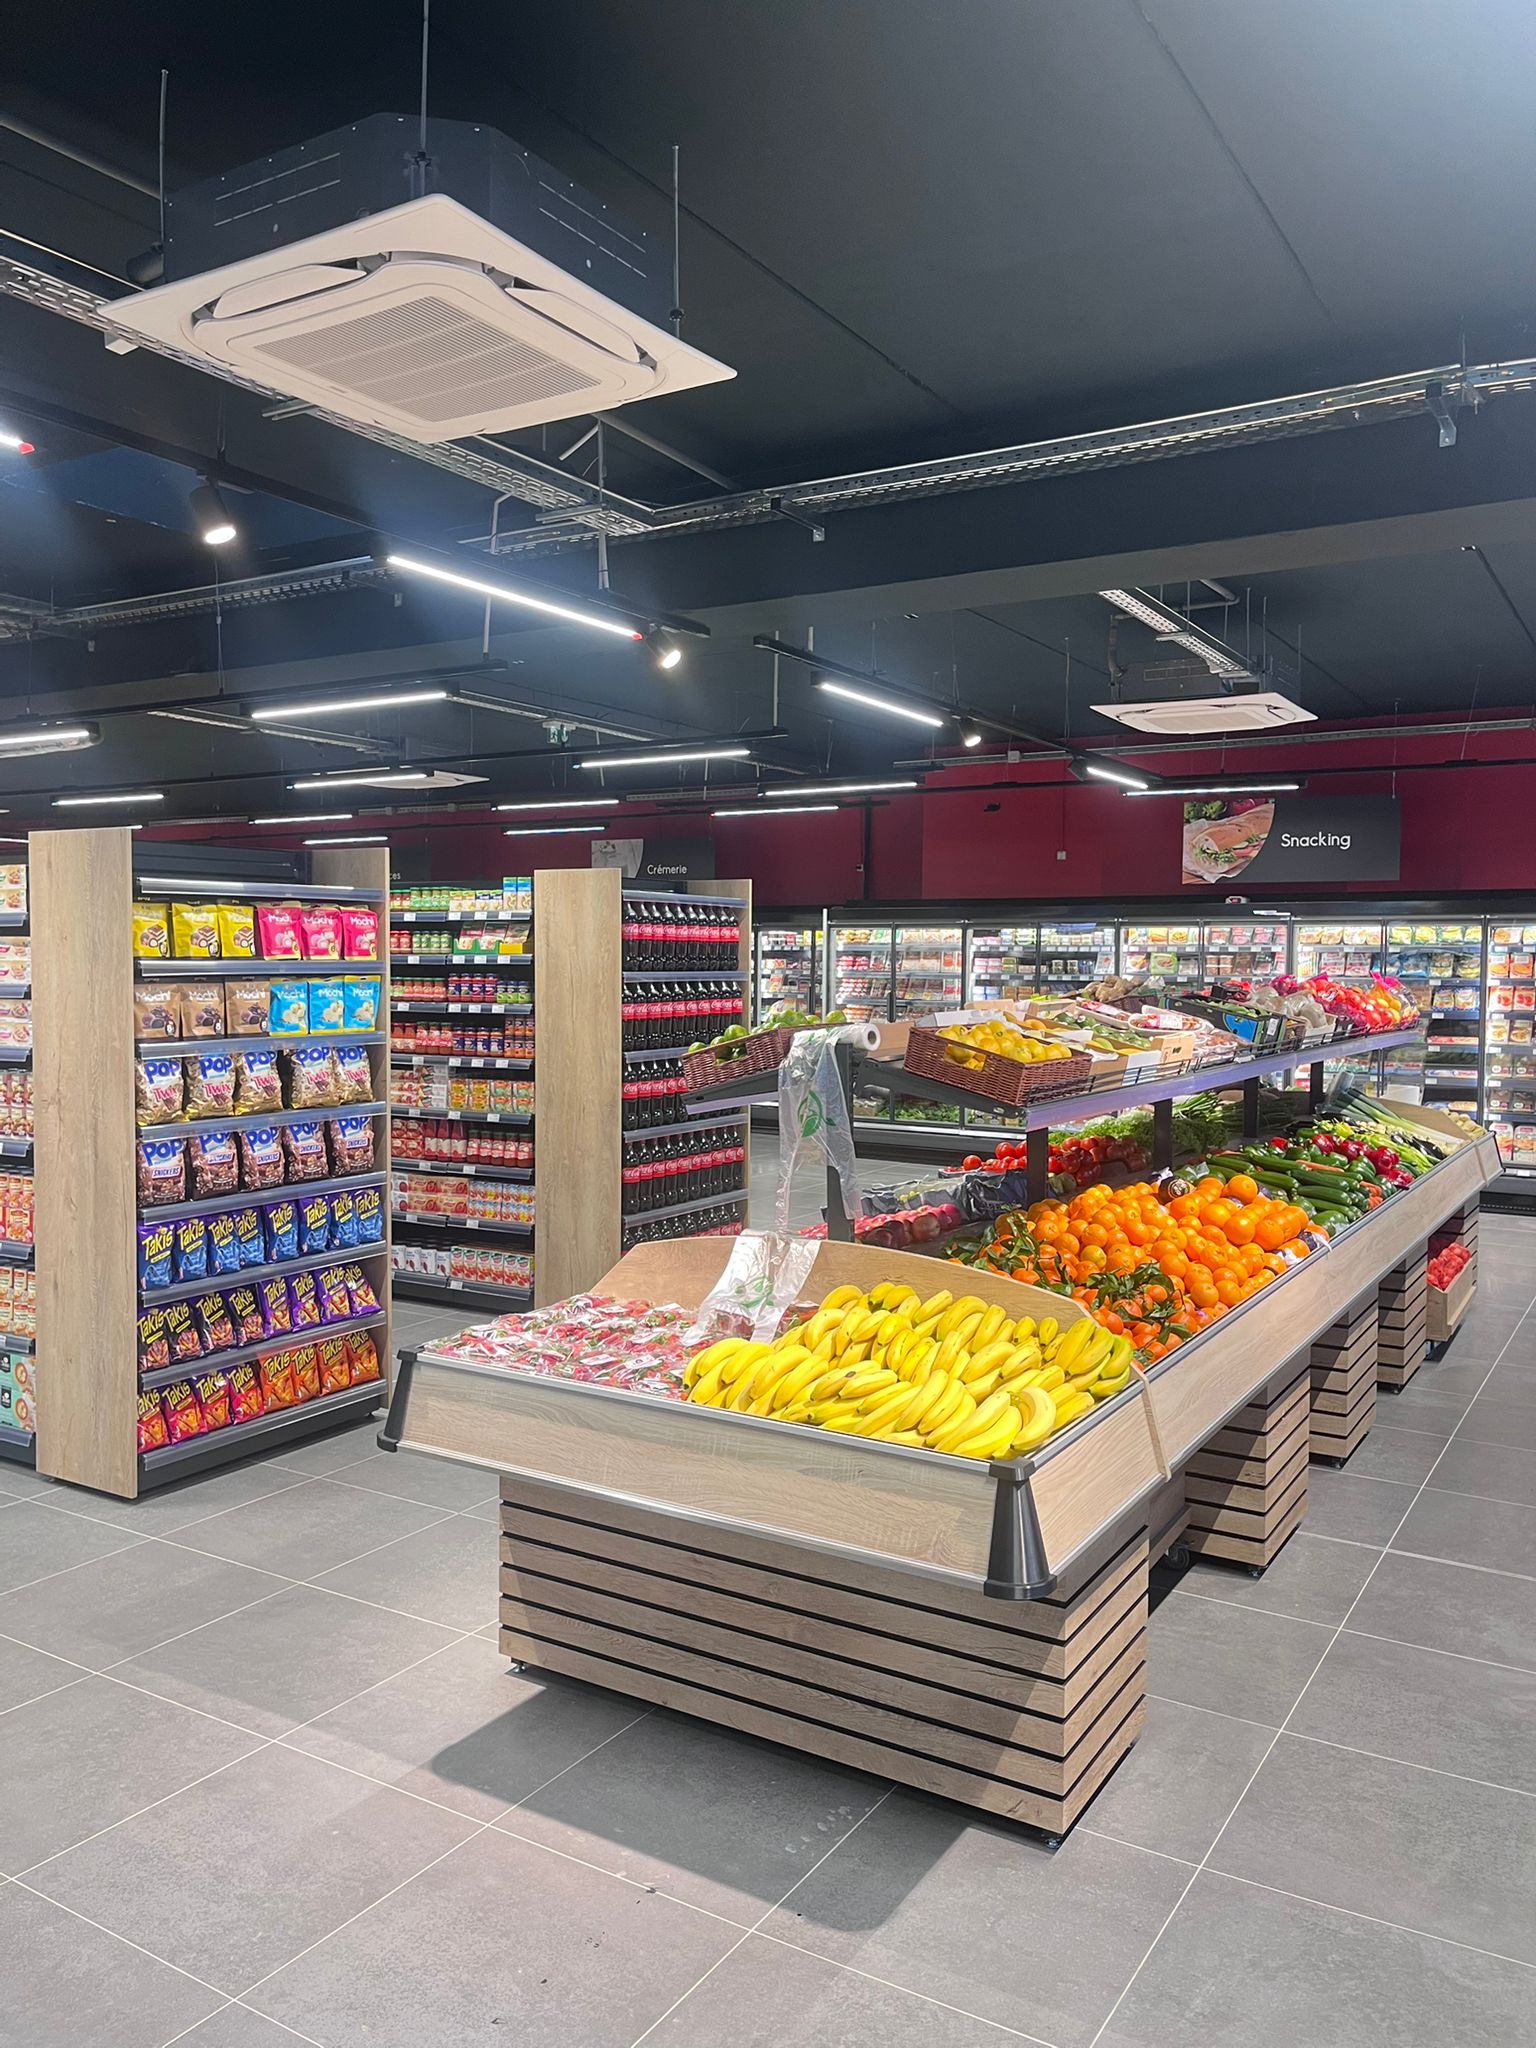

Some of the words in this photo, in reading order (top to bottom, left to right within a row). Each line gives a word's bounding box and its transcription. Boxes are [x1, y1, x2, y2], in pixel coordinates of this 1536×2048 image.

[1281, 831, 1351, 850] Snacking
[647, 863, 687, 875] Crémerie
[350, 916, 374, 926] Mochi
[135, 991, 171, 1002] Mochi
[200, 1057, 232, 1079] POP
[243, 1051, 277, 1073] POP
[297, 1047, 331, 1068] POP
[337, 1046, 366, 1067] POP
[144, 1061, 180, 1084] POP
[346, 1069, 368, 1082] Twix
[204, 1083, 232, 1097] Twix
[141, 1140, 182, 1166] POP
[257, 1153, 279, 1163] SNICKERS
[153, 1167, 179, 1177] SNICKERS
[304, 1200, 328, 1227] Takis
[331, 1196, 353, 1221] Takis
[355, 1192, 380, 1217] Takis
[208, 1217, 234, 1245] Takis
[269, 1205, 293, 1233] Takis
[142, 1230, 173, 1261] Takis
[176, 1220, 205, 1251] Takis
[264, 1279, 286, 1308] Takis
[292, 1275, 315, 1301] Takis
[319, 1267, 344, 1295] Takis
[196, 1293, 223, 1325] Takis
[229, 1290, 254, 1315] Takis
[136, 1311, 165, 1343] Takis
[164, 1302, 189, 1332] Takis
[320, 1337, 343, 1365] Takis
[346, 1330, 369, 1353] Takis
[264, 1352, 291, 1382] Takis
[292, 1344, 315, 1375] Takis
[196, 1372, 224, 1403] Takis
[228, 1365, 254, 1393] Takis
[162, 1382, 191, 1411] Takis
